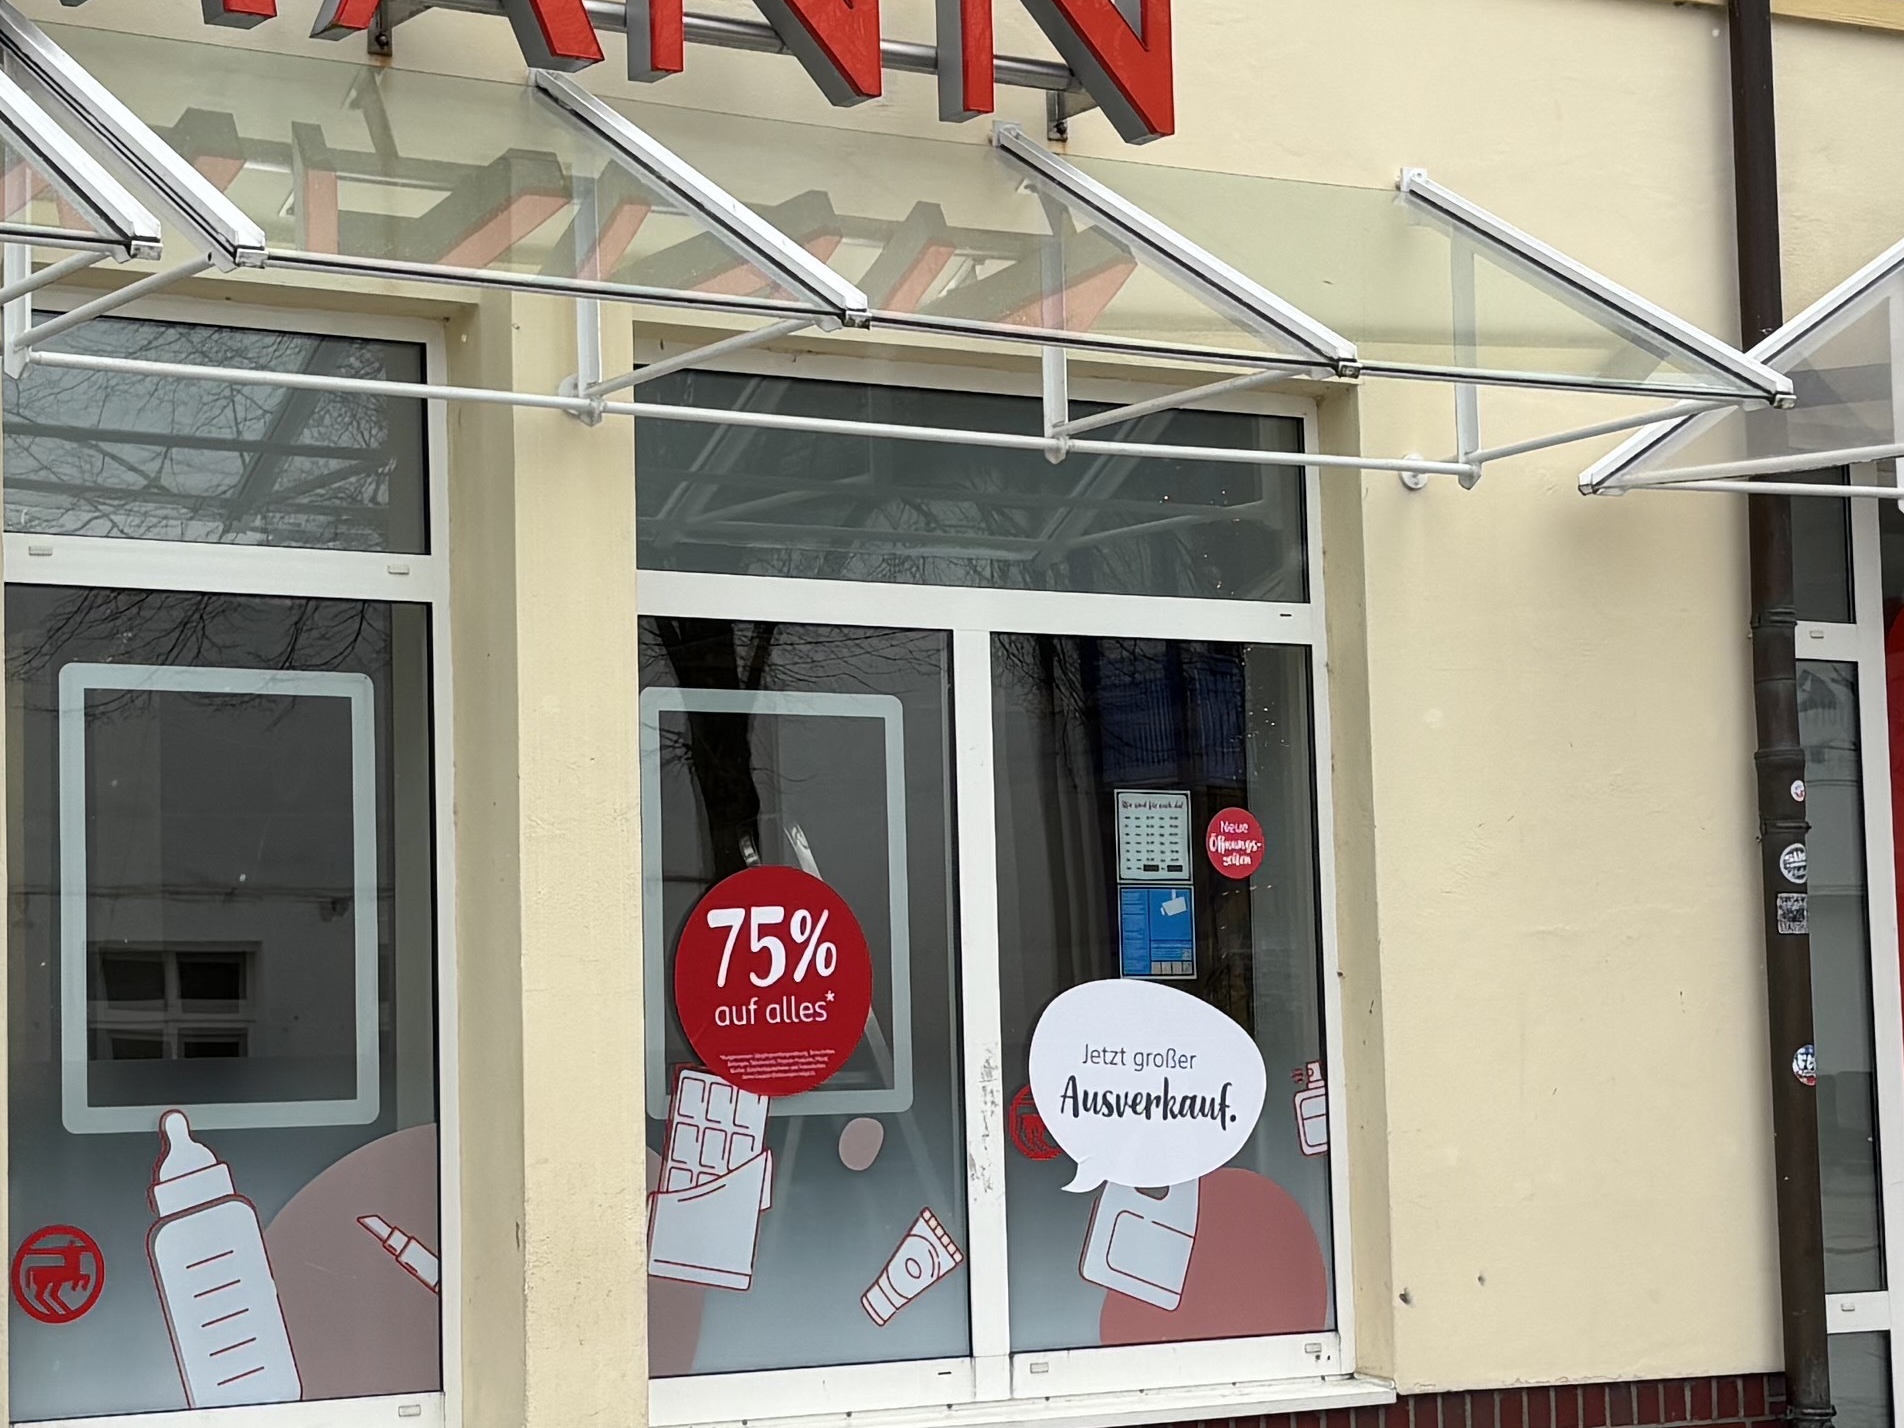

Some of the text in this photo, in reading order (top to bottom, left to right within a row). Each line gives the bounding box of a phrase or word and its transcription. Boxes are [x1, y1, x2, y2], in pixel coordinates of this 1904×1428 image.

[707, 906, 837, 987] 75%
[714, 997, 759, 1026] auf
[1082, 1043, 1197, 1072] Jetzt großer
[1060, 1075, 1237, 1131] Ausverkauf.
